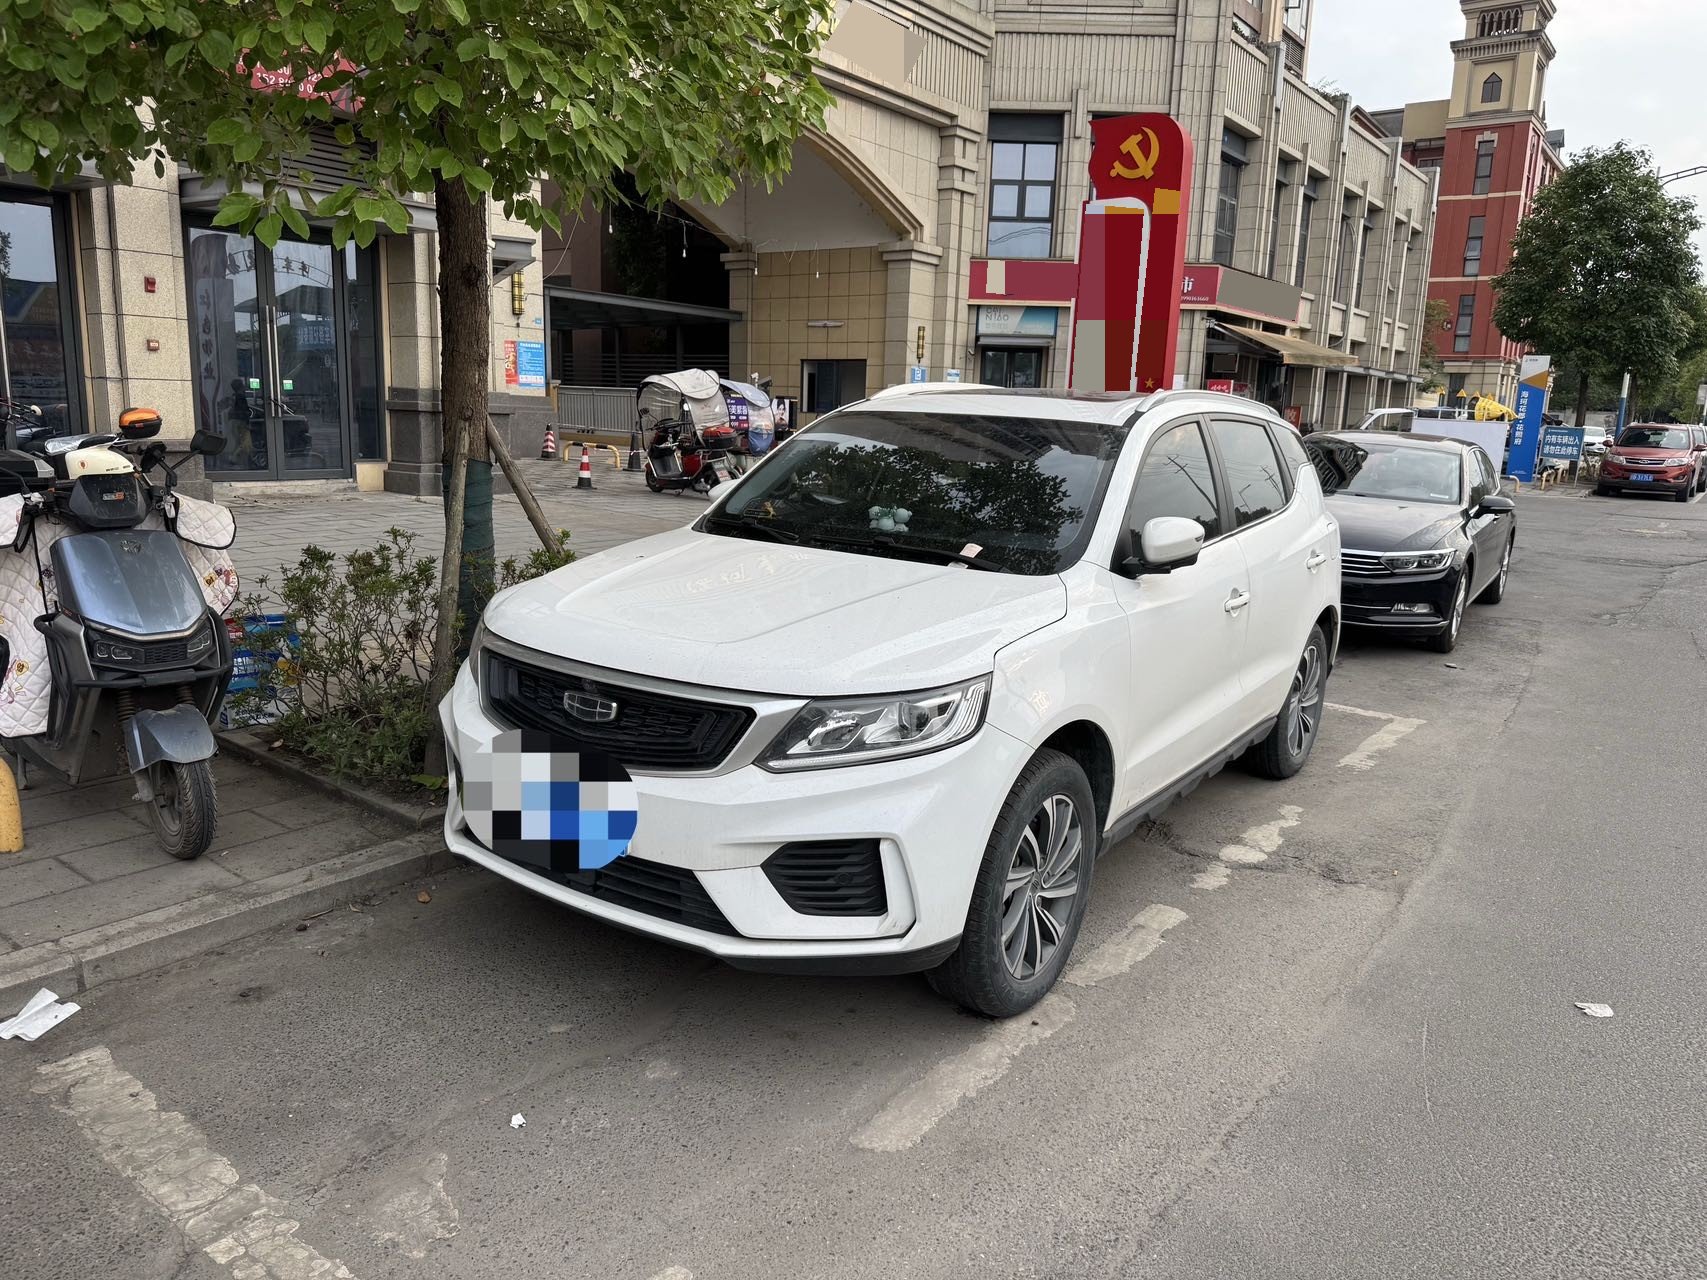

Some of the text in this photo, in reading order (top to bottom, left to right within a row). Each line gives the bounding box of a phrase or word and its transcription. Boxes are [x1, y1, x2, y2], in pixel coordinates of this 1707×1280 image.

[1545, 435, 1580, 445] 内有车辆出入
[1543, 445, 1579, 455] 请勿在此停车
